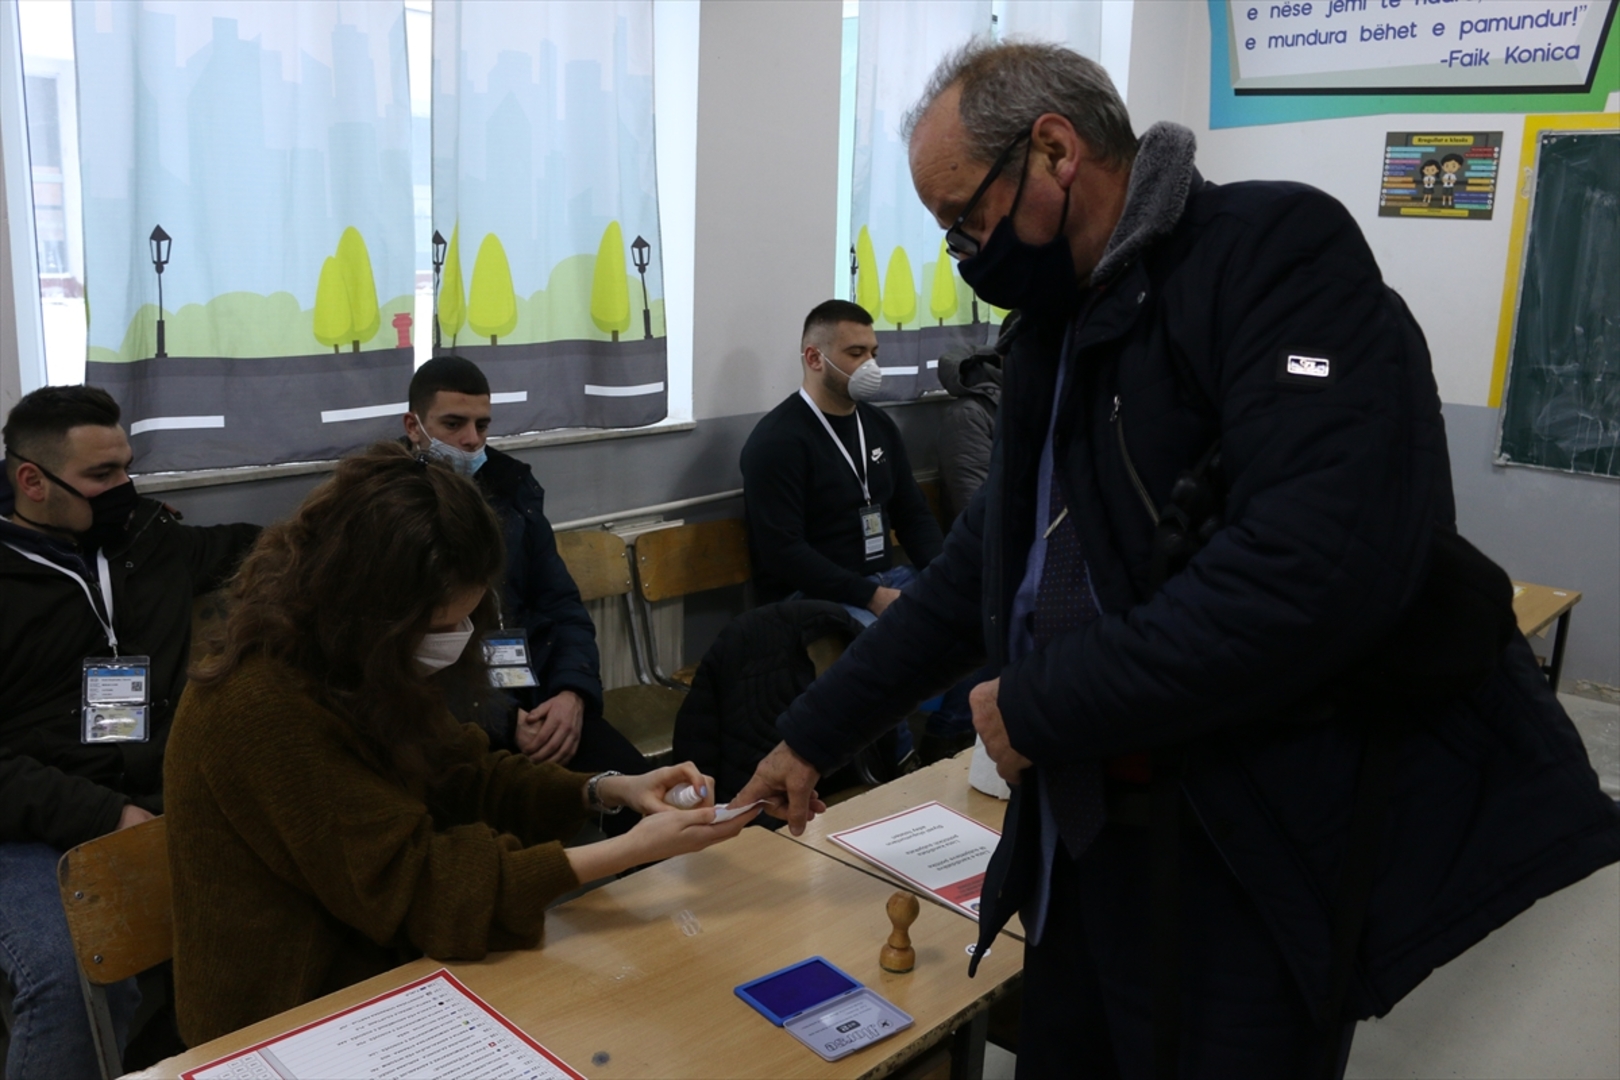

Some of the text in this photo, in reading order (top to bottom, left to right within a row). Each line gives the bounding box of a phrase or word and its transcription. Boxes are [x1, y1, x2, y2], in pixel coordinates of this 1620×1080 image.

[1247, 7, 1258, 20] e
[1270, 1, 1313, 19] nëse
[1245, 37, 1256, 50] e
[1268, 29, 1347, 49] mundura
[1360, 22, 1418, 42] bëhet
[1432, 22, 1445, 36] e
[1440, 43, 1580, 68] -Faik Konica
